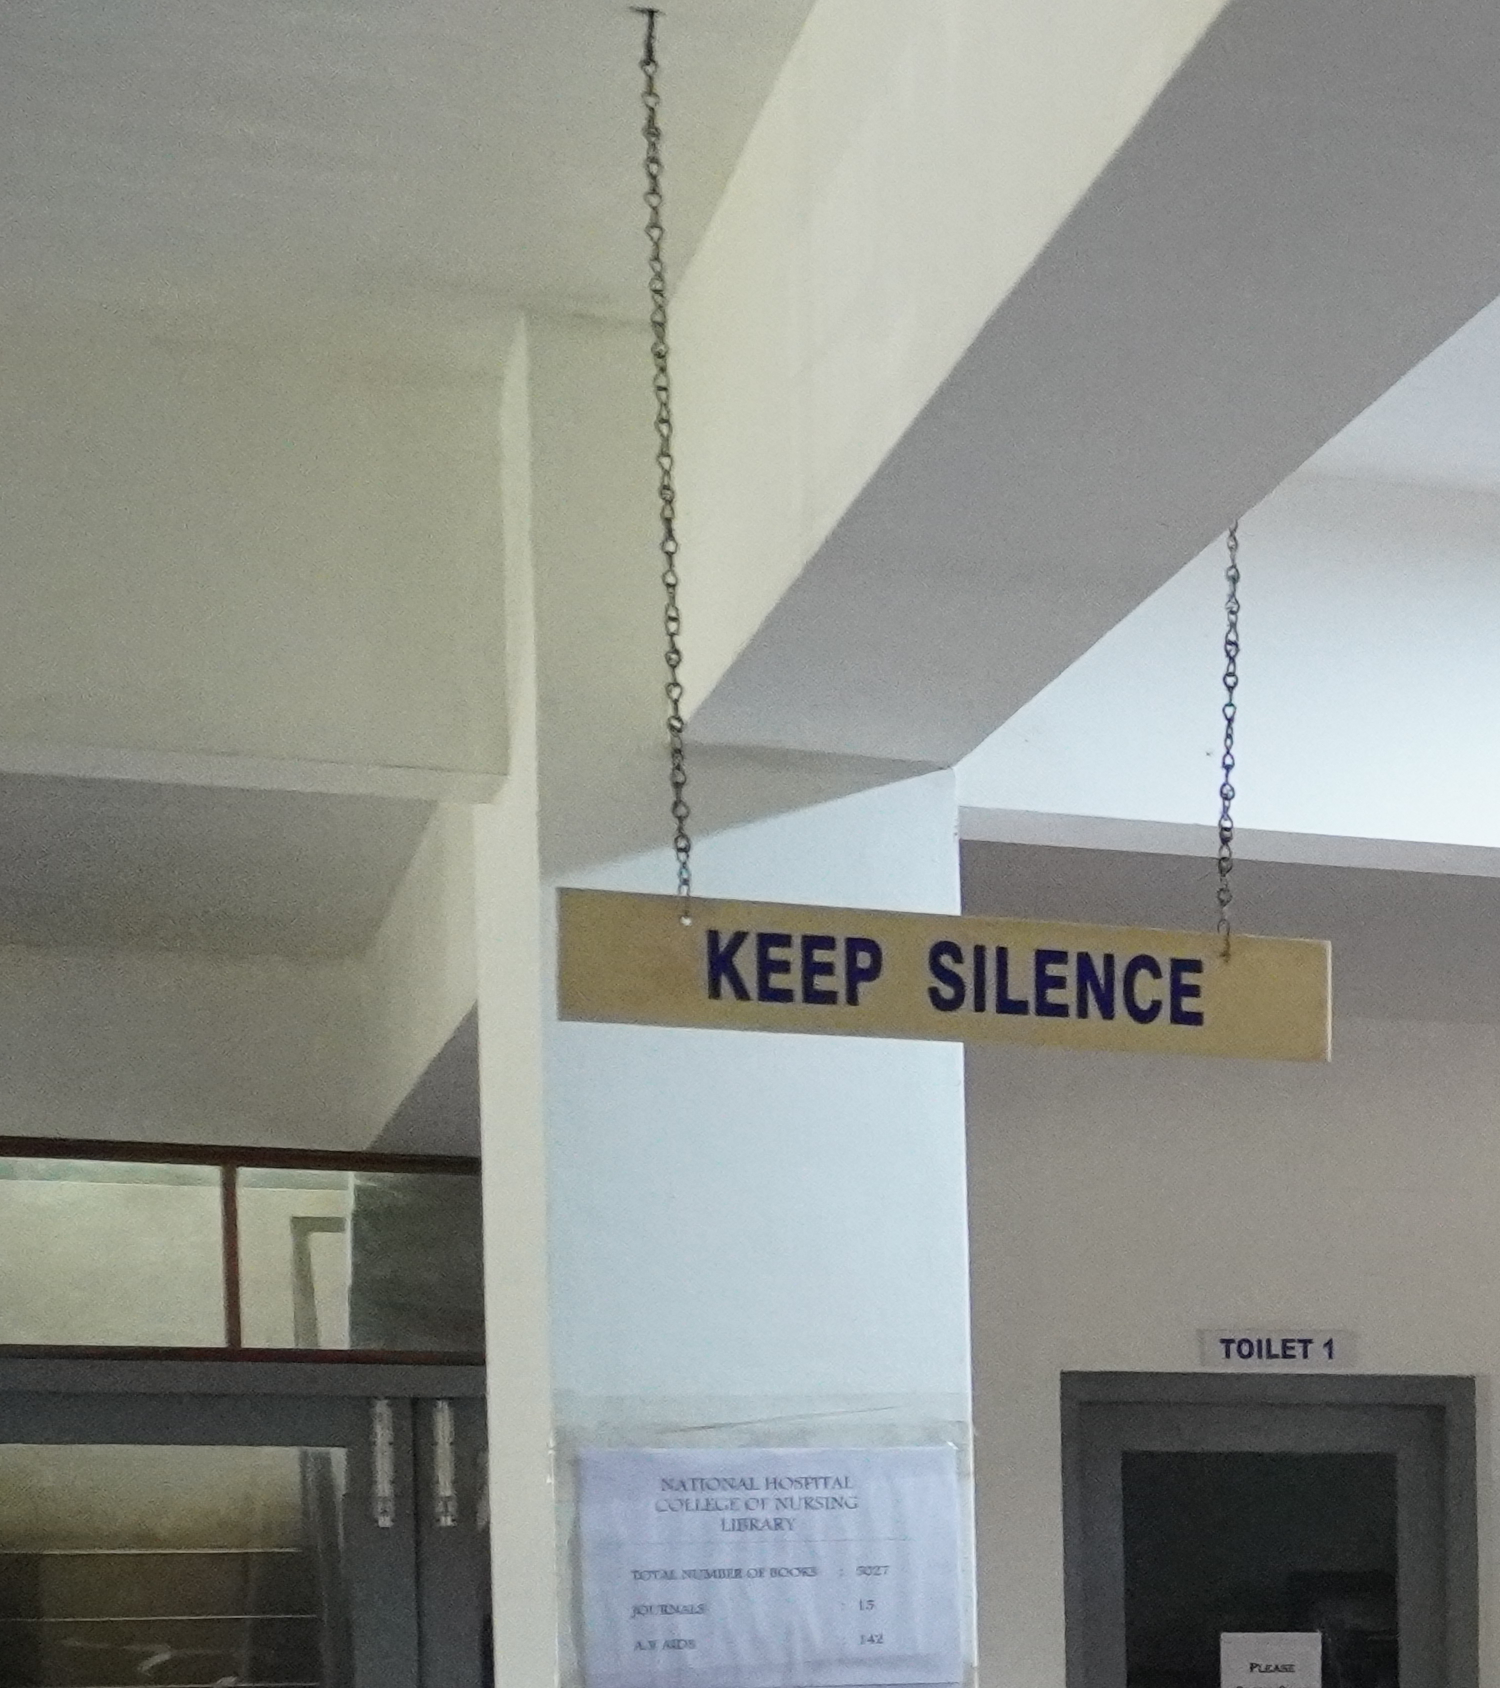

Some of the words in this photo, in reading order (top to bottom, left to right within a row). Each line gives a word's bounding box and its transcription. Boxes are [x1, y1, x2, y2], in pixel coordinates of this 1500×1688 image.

[706, 929, 882, 1006] KEEP
[928, 940, 1204, 1026] SILENCE
[1219, 1337, 1314, 1360] TOILET
[1323, 1337, 1334, 1360] 1
[661, 1476, 759, 1492] NATIONAL
[765, 1475, 854, 1490] HOSPITAL
[654, 1496, 741, 1512] COLLEGE
[745, 1496, 769, 1511] OF
[774, 1495, 859, 1510] NURSING
[720, 1517, 797, 1532] LIBRARY
[631, 1569, 676, 1581] TOTAL
[681, 1568, 743, 1580] NUMBER
[746, 1567, 766, 1579] OF
[769, 1566, 818, 1578] BOOKS
[630, 1603, 706, 1619] JOURNALS
[1249, 1662, 1296, 1674] PLEASE
